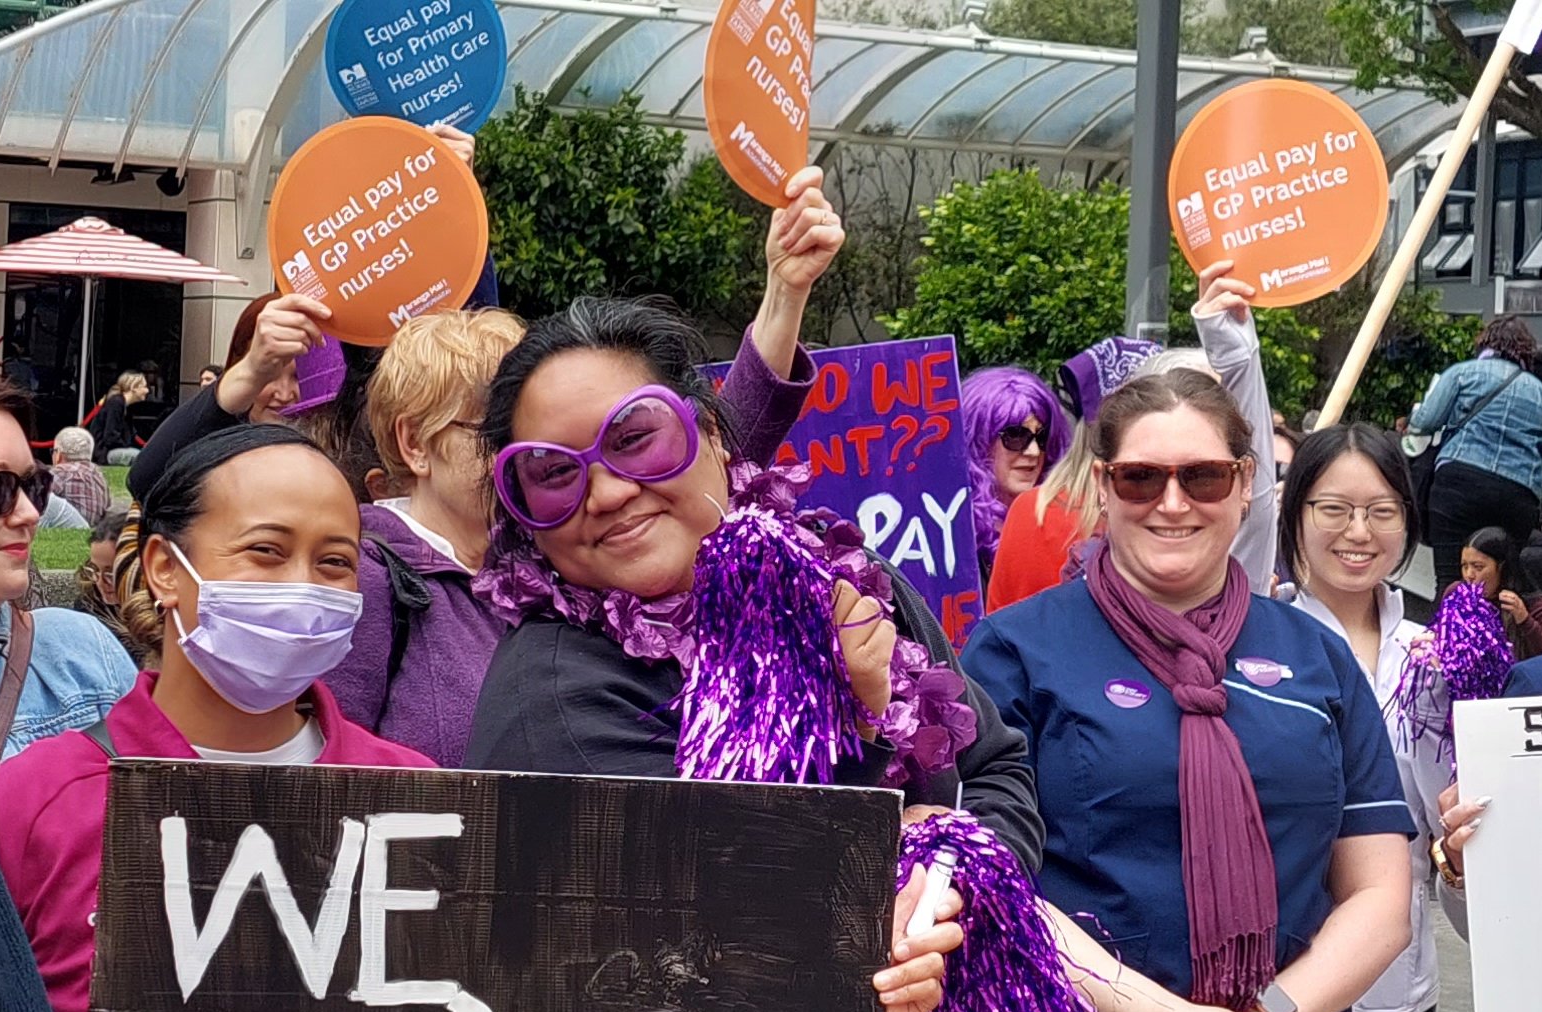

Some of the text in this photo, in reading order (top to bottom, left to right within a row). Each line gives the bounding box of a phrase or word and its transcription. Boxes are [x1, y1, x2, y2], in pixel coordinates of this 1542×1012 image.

[364, 0, 451, 47] Equal pay
[377, 11, 474, 70] for Primary
[765, 25, 793, 57] GP
[387, 54, 450, 93] Health
[450, 32, 490, 61] Care
[400, 72, 464, 117] nurses!
[746, 56, 806, 132] nurses!
[1204, 130, 1358, 192] Equal pay for
[302, 147, 438, 247] Equal pay for
[1213, 166, 1349, 220] GP Practice
[320, 186, 440, 272] GP Practice
[1221, 206, 1307, 251] nurses!
[338, 238, 414, 300] nurses!
[871, 352, 958, 415] WE
[857, 487, 969, 579] PAY
[160, 812, 465, 1007] WE
